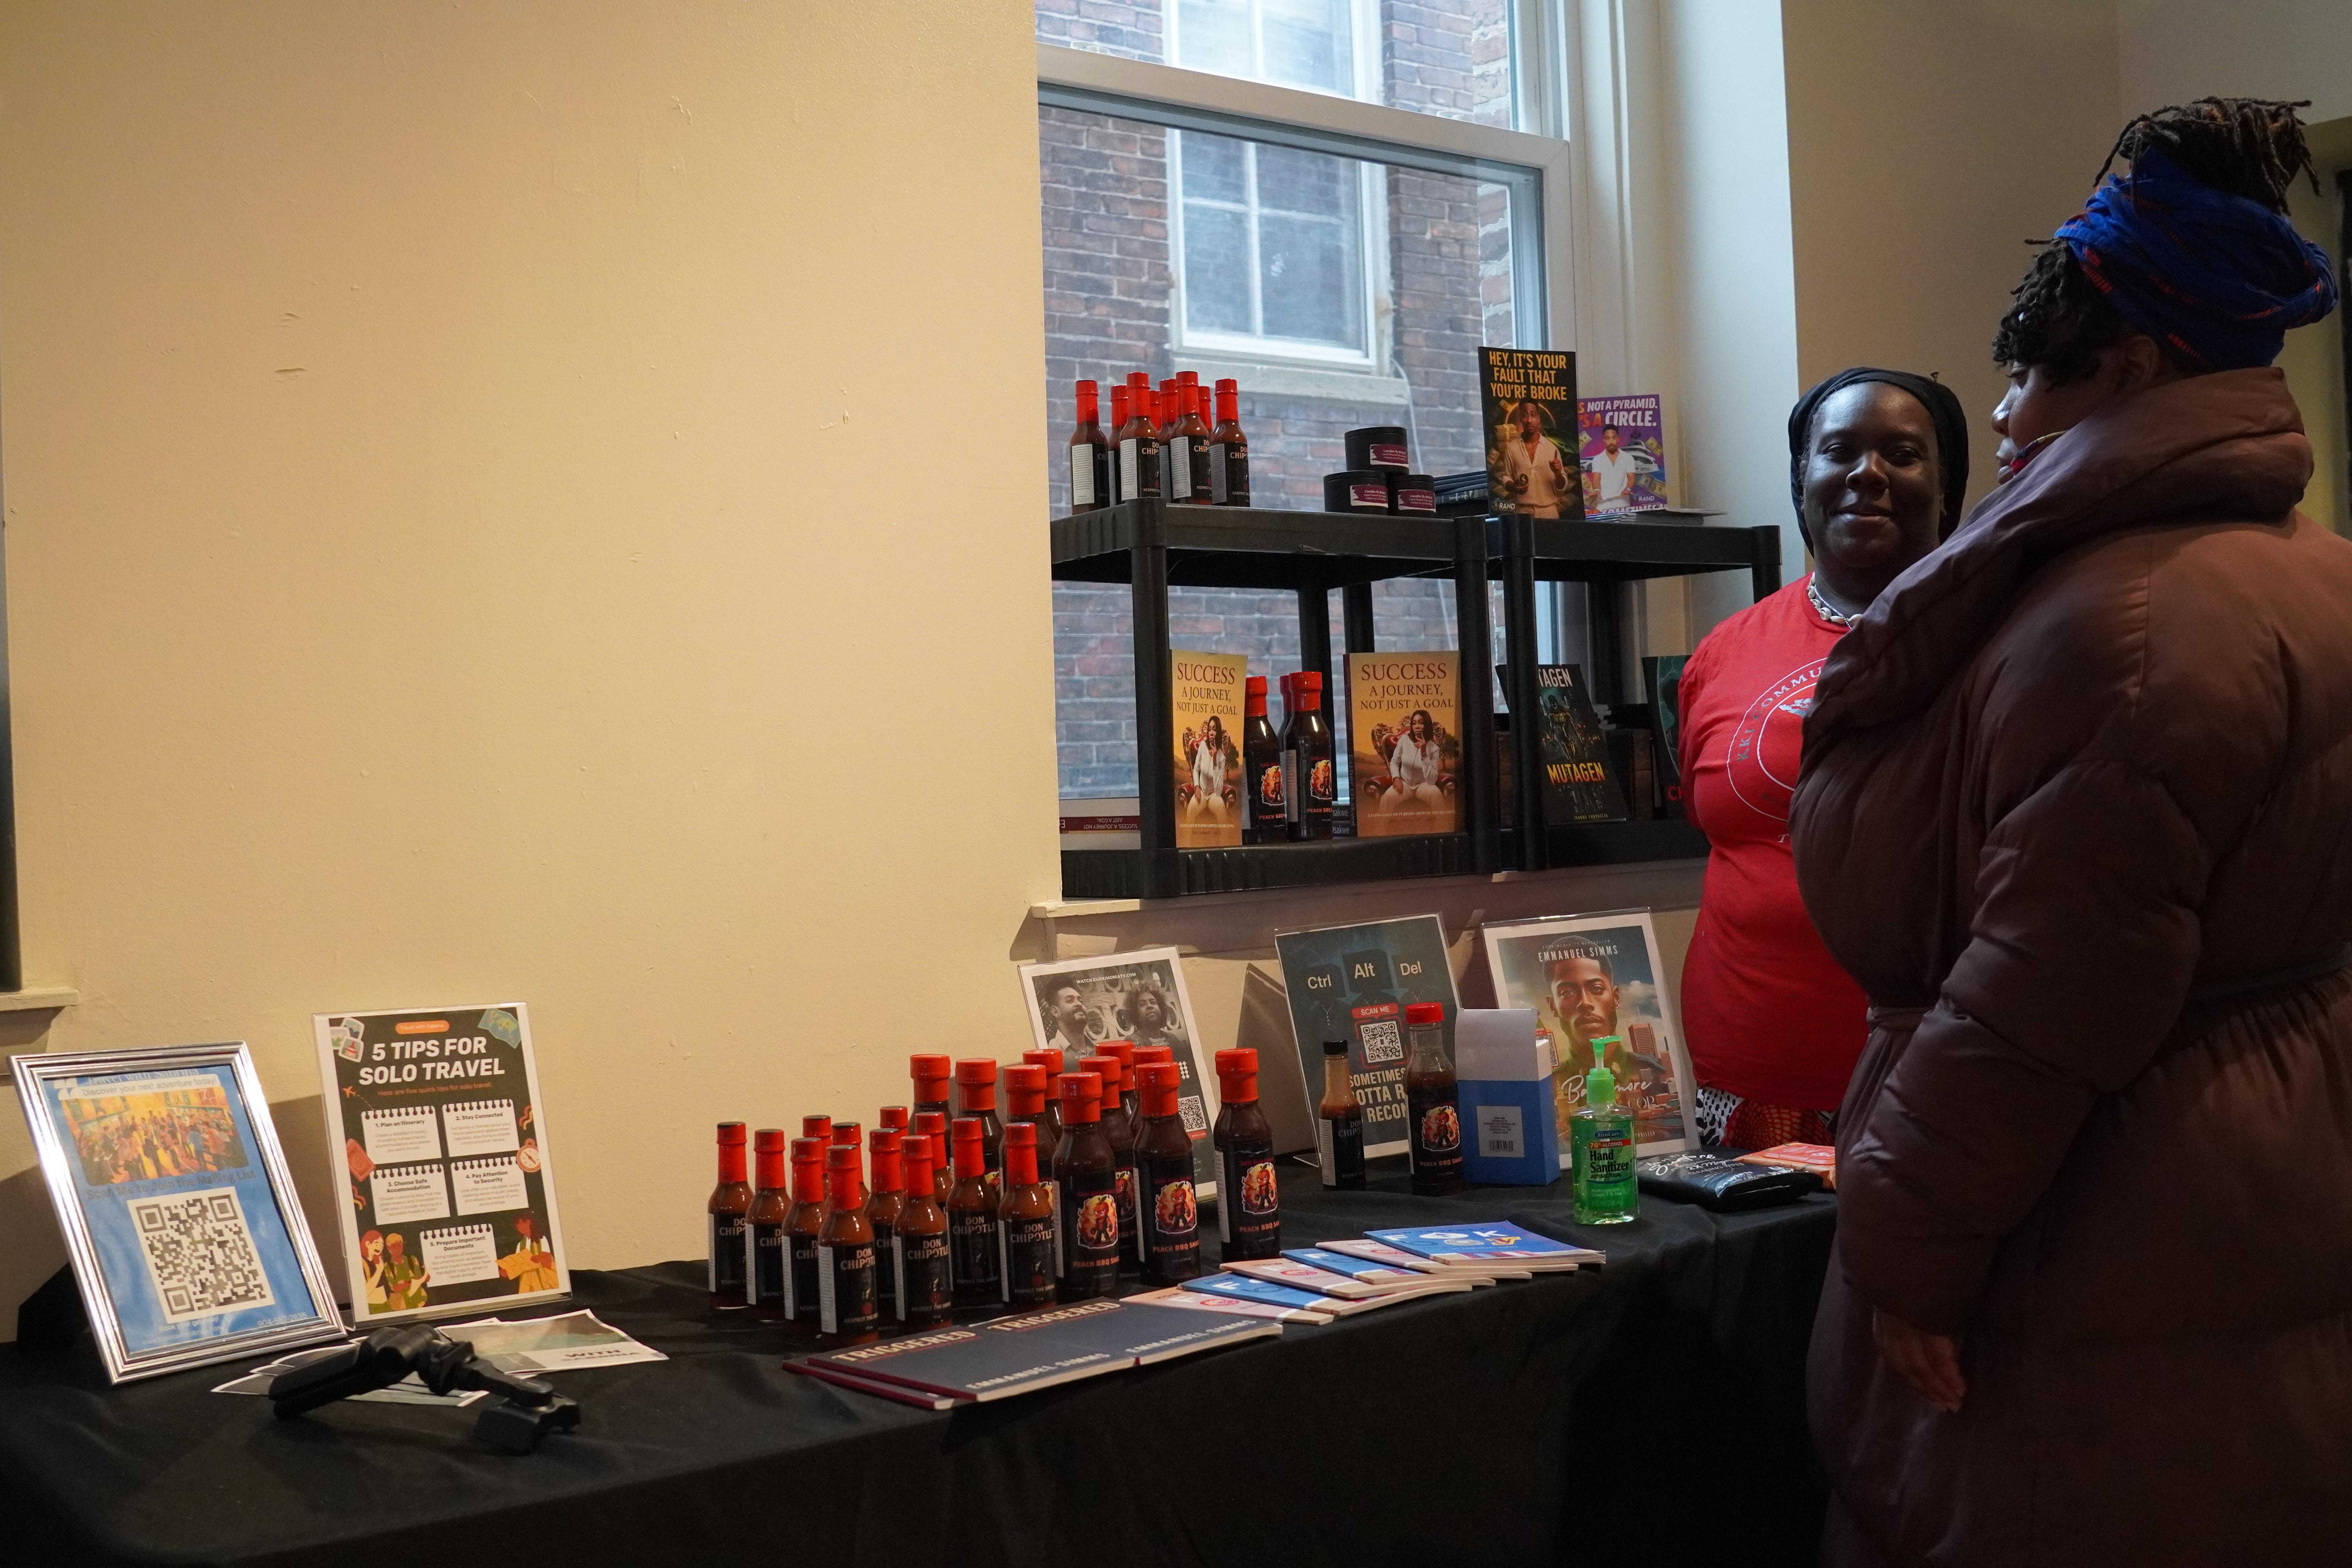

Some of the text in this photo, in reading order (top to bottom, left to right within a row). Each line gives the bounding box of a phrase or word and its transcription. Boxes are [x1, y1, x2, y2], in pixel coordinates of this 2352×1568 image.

[1489, 351, 1566, 369] HEY, IT'S YOUR
[1494, 367, 1556, 384] FAULT THAT
[1490, 383, 1567, 400] YOU'RE BROKE
[1587, 397, 1658, 412] NOT A PYRAMID.
[1593, 410, 1657, 427] A CIRCLE.
[1178, 662, 1235, 684] SUCCESS
[1361, 663, 1446, 681] SUCCESS
[1182, 686, 1231, 703] A JOURNEY,
[1370, 684, 1443, 699] A JOURNEY,
[1177, 701, 1238, 715] NOT JUST A GOAL
[1361, 699, 1454, 711] NOT JUST A GOAL
[1547, 762, 1606, 784] MUTAGEN
[1538, 945, 1618, 962] EMMANUEL SIMMS
[1354, 963, 1375, 979] Alt
[1400, 961, 1422, 976] Del
[1076, 972, 1136, 984] WATCH.EUDAIMONIATV.COM
[1308, 975, 1332, 989] Ctrl
[1361, 1007, 1378, 1016] SCAN
[372, 1036, 486, 1061] 5 TIPS FOR
[359, 1058, 505, 1085] SOLO TRAVEL
[83, 1085, 118, 1096] Discover
[120, 1084, 137, 1094] your
[138, 1082, 154, 1091] next
[156, 1079, 192, 1089] adventure
[1352, 1085, 1392, 1105] OTTA
[1590, 1149, 1613, 1161] Hand
[1590, 1160, 1630, 1173] Sanitizer
[387, 1185, 431, 1193] Accommodation
[953, 1222, 996, 1234] CHIPOTLE
[965, 1216, 984, 1225] DON
[1025, 1223, 1043, 1232] DON
[923, 1238, 941, 1249] DON
[856, 1247, 872, 1259] DON
[987, 1301, 1122, 1330] TRIGGERED
[566, 1349, 621, 1357] WITH
[831, 1330, 976, 1362] TRIGGERED
